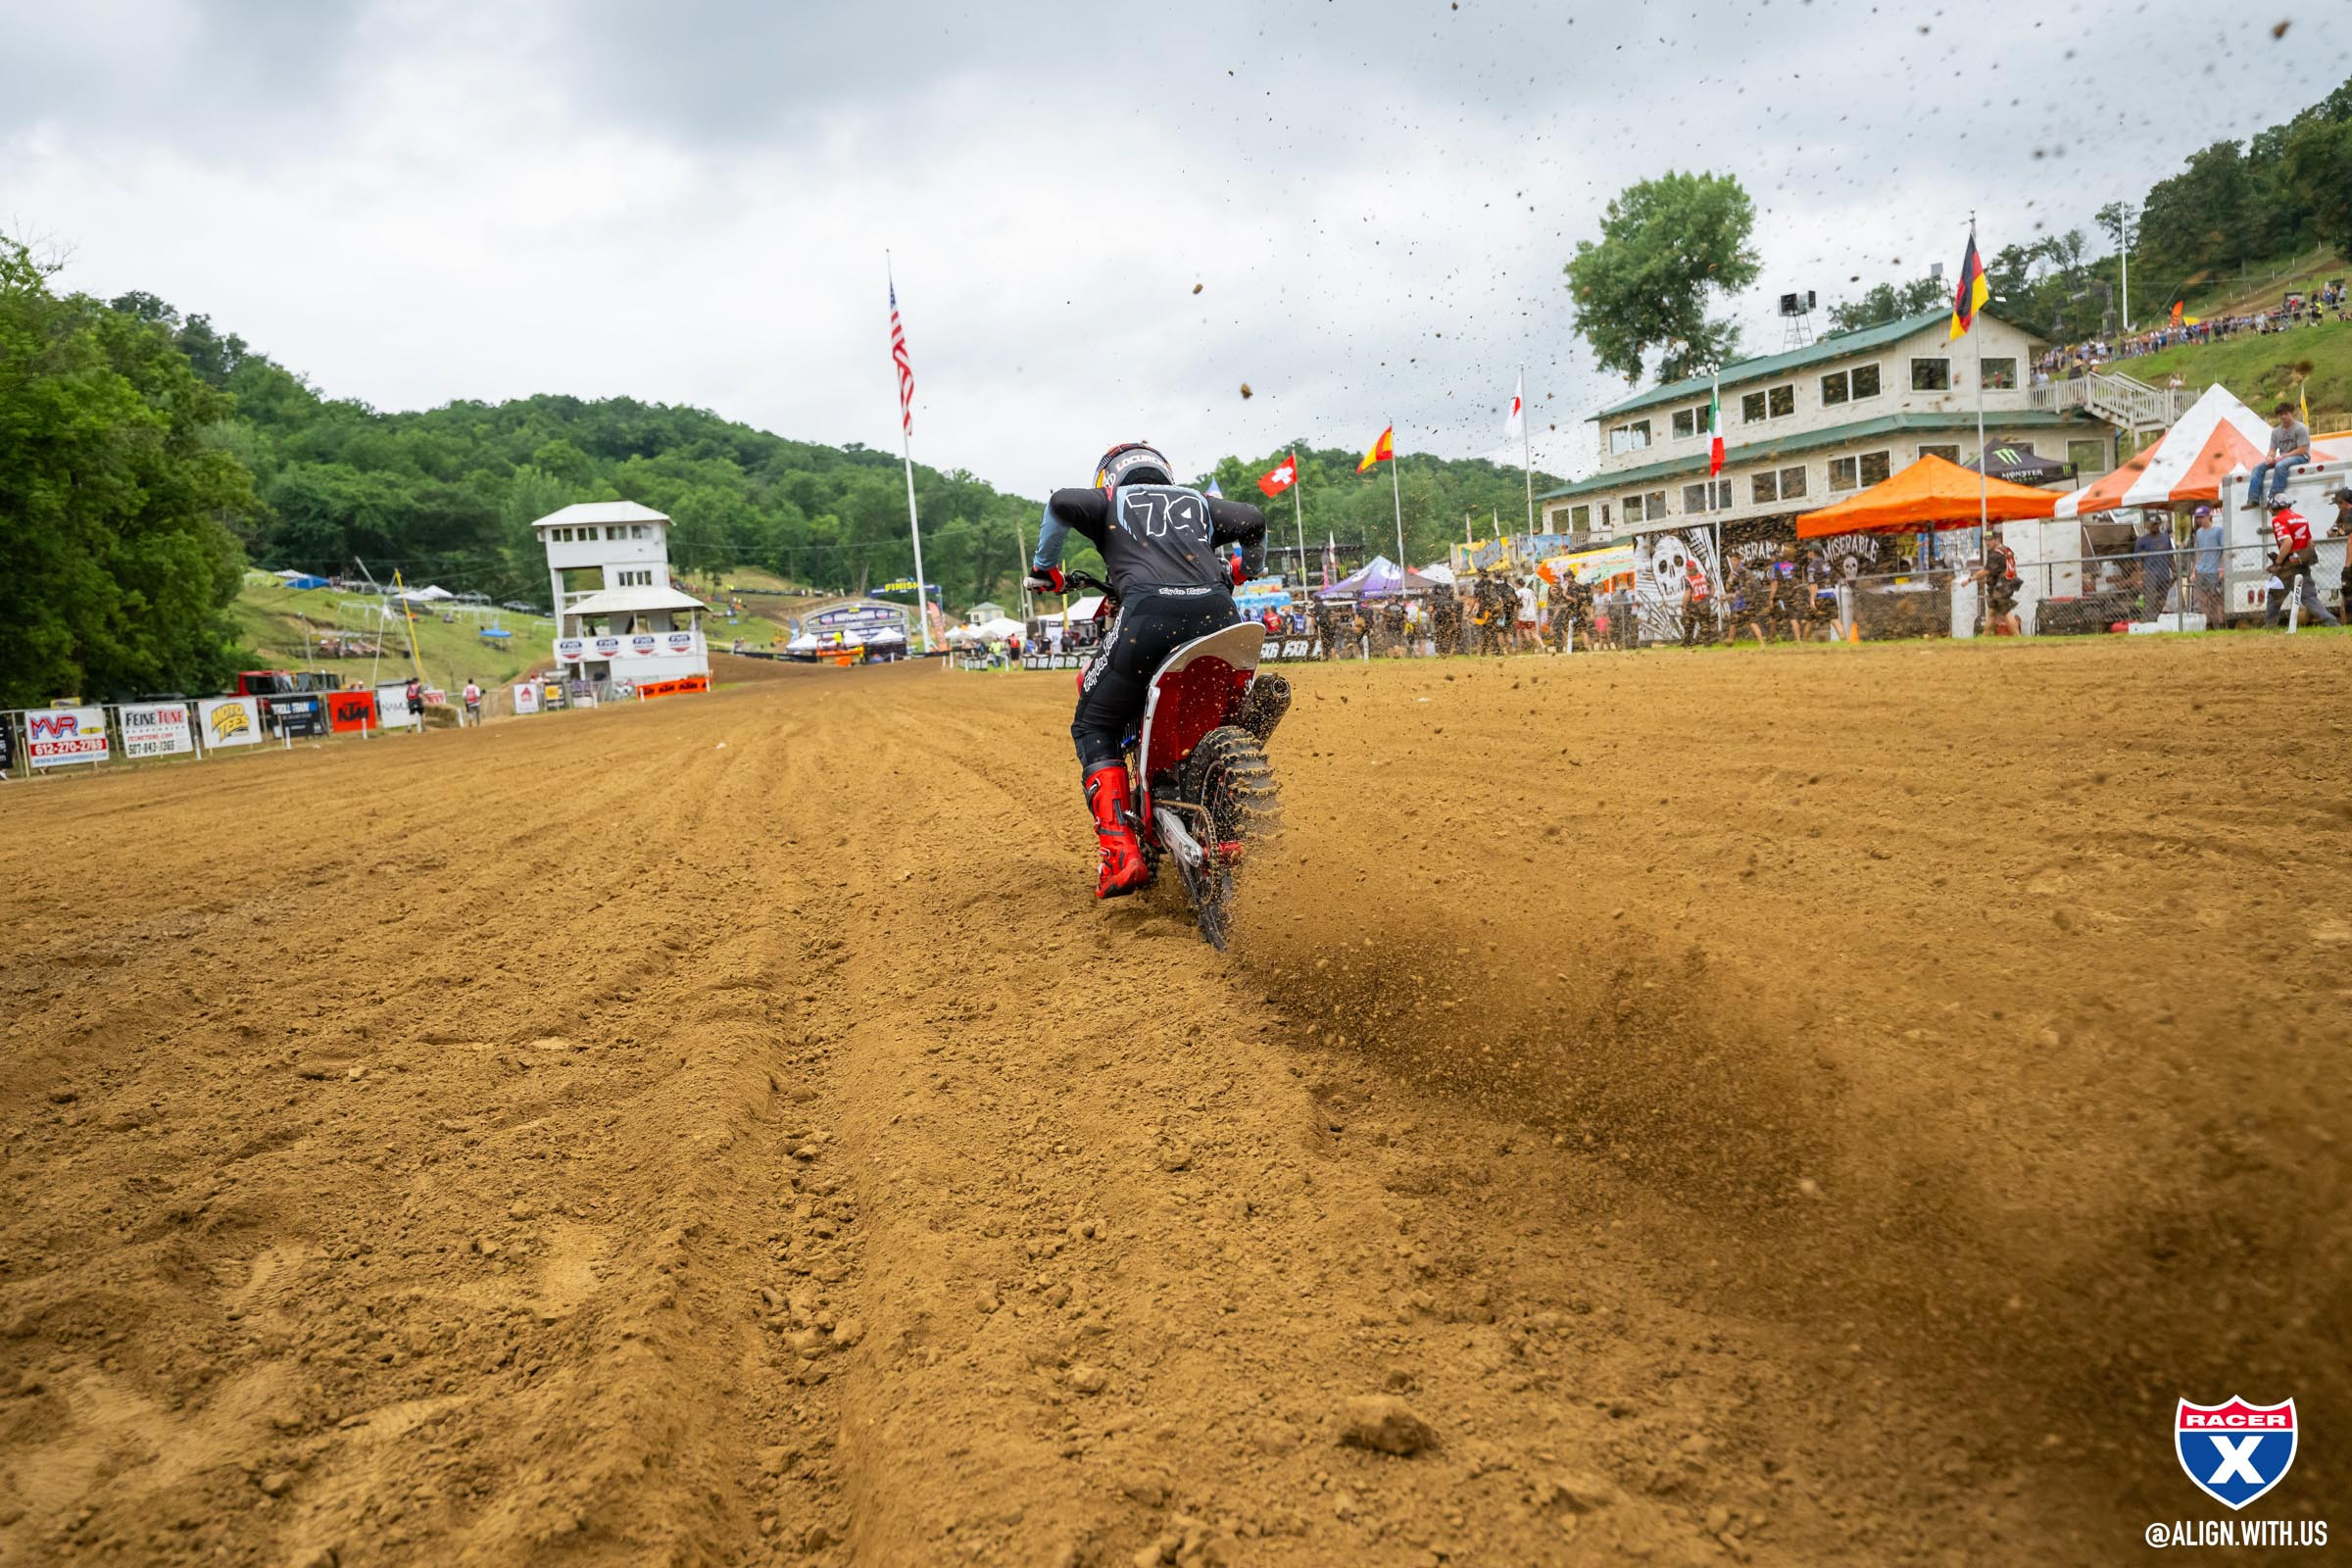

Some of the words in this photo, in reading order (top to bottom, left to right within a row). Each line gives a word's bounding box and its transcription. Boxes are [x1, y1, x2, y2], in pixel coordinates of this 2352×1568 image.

[1116, 455, 1168, 472] LOCURC
[2001, 469, 2043, 479] MONSTER
[1125, 490, 1208, 542] 74
[211, 703, 245, 726] MOTO
[337, 701, 369, 722] KTM
[29, 715, 78, 739] MVR
